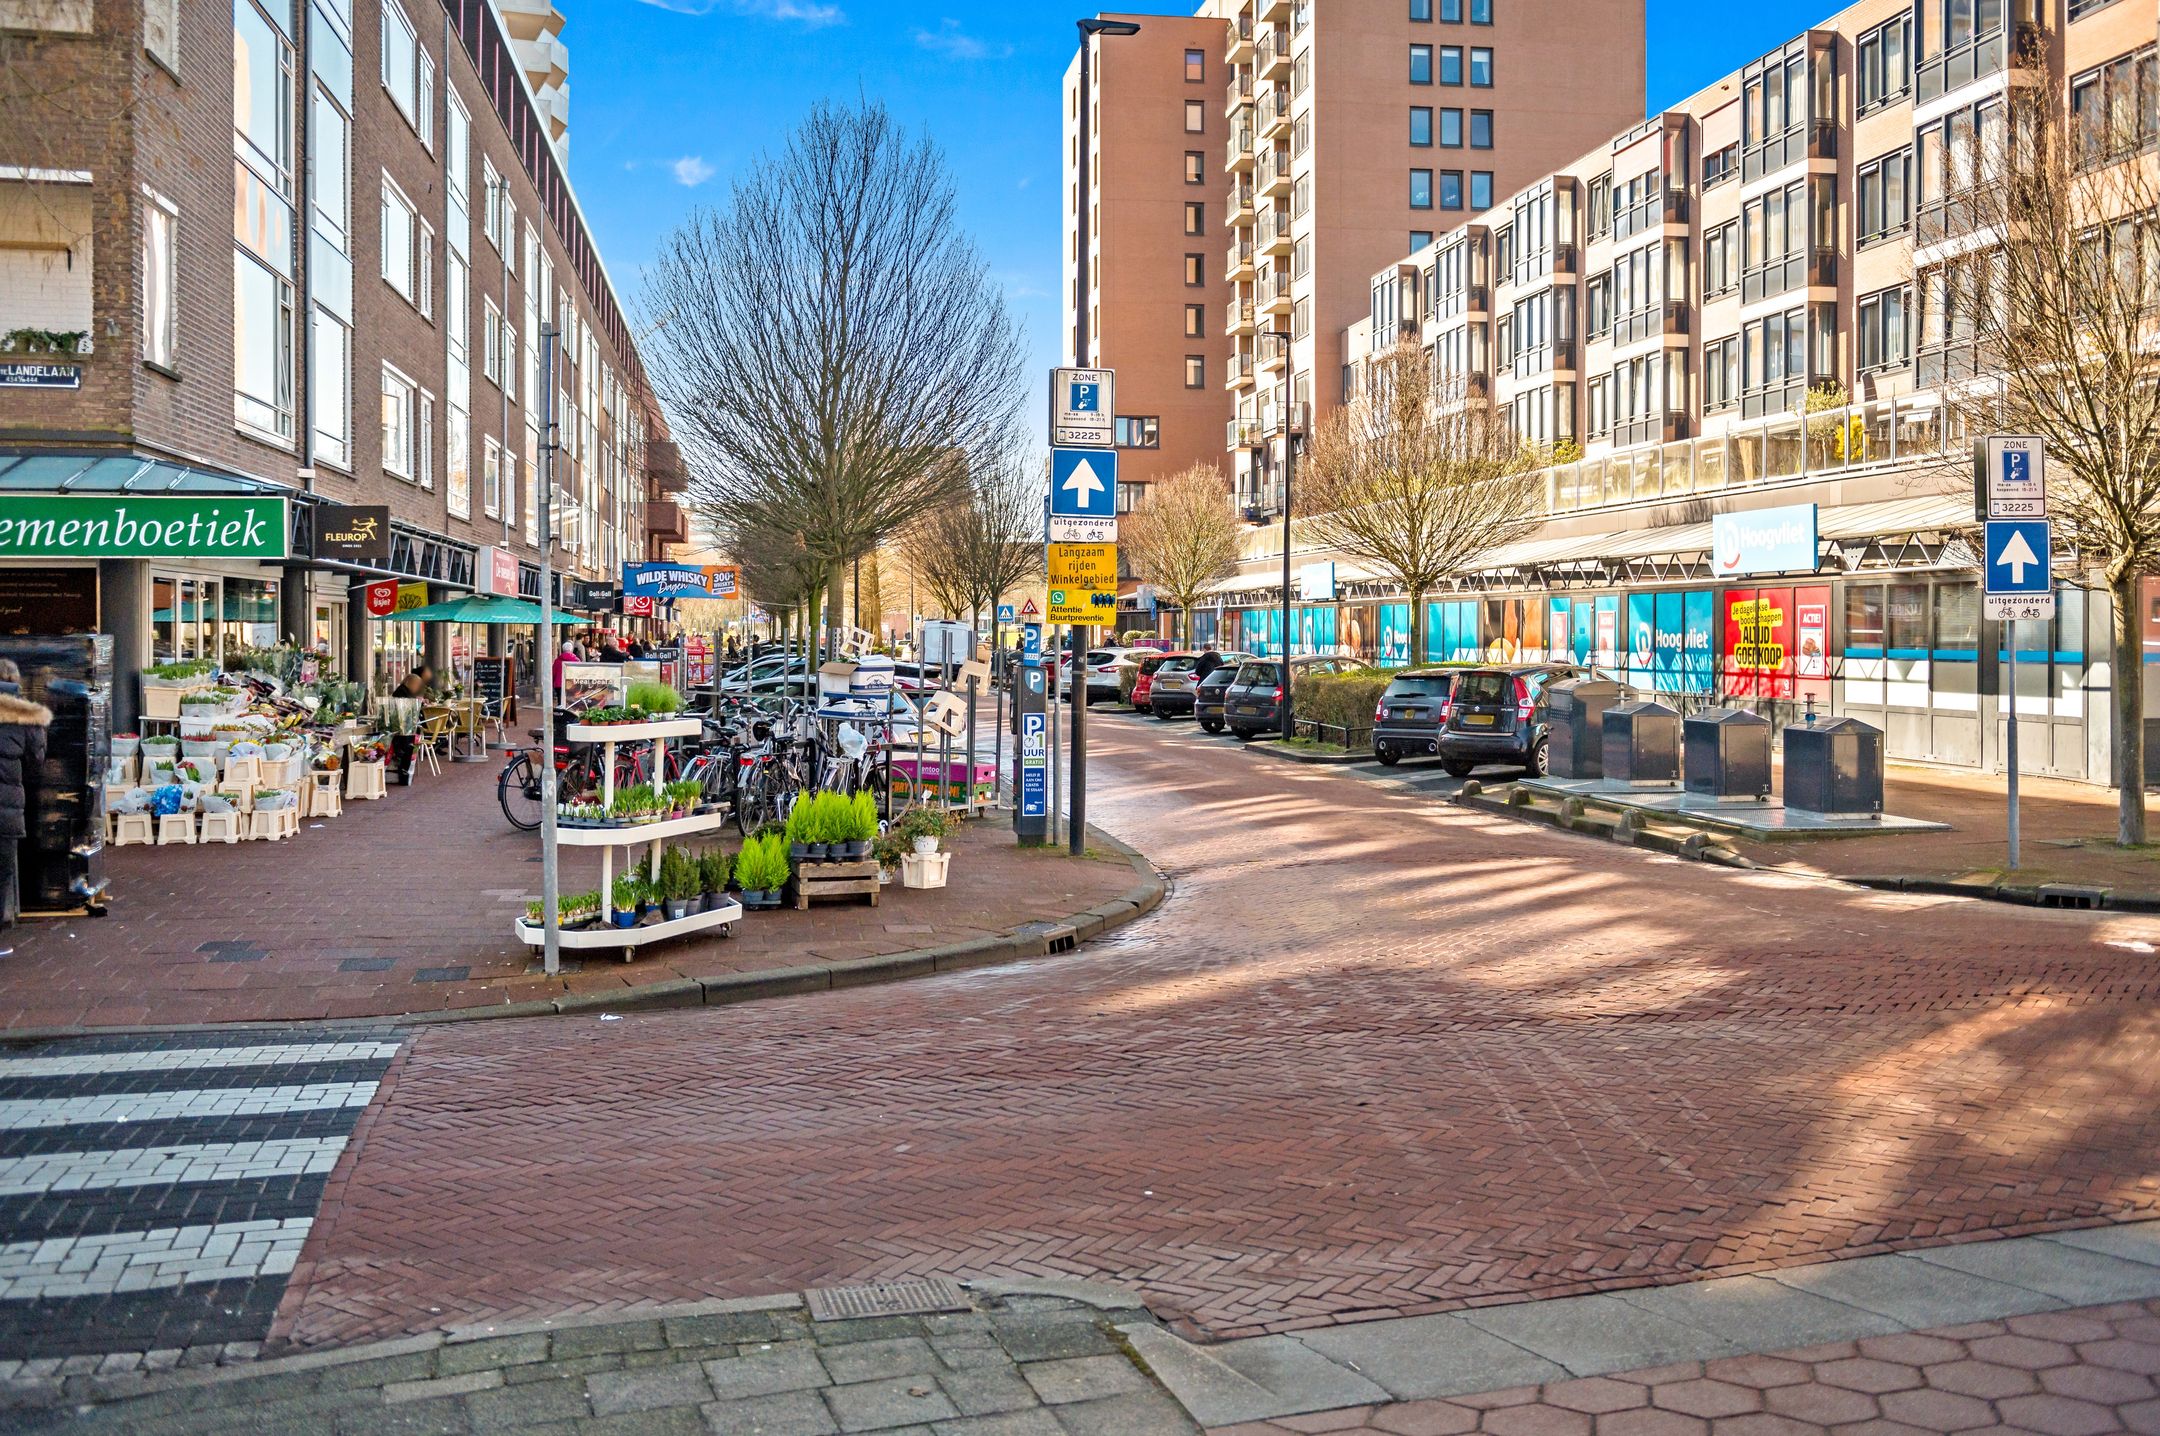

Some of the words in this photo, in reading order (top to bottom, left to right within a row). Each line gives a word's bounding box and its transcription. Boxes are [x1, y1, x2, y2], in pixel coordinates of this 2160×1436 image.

[8, 365, 75, 377] LANDELAAN
[1072, 373, 1098, 381] ZONE
[1080, 385, 1090, 399] P
[1068, 431, 1102, 440] 32225
[2004, 441, 2028, 449] ZONE
[2011, 453, 2021, 468] P
[2002, 503, 2034, 512] 32225
[1053, 519, 1115, 528] uitgezonderd
[325, 533, 368, 542] FLEUROP
[1740, 520, 1806, 551] Hoogvliet
[1058, 547, 1105, 559] Langzaam
[1068, 561, 1096, 574] rijden
[636, 570, 668, 586] WILDE
[668, 570, 708, 587] WHISKY
[713, 572, 734, 583] 300+
[1050, 574, 1114, 587] Winkelgebied
[1988, 597, 2051, 606] uitgezonderd
[1050, 614, 1105, 622] Buurtpreventie
[1025, 628, 1038, 648] P
[1656, 628, 1709, 653] Hoogvliet
[1743, 625, 1770, 644] ALTJD
[1030, 672, 1041, 689] P
[1027, 716, 1042, 736] P
[1036, 733, 1043, 747] 1
[1024, 749, 1045, 757] UUR
